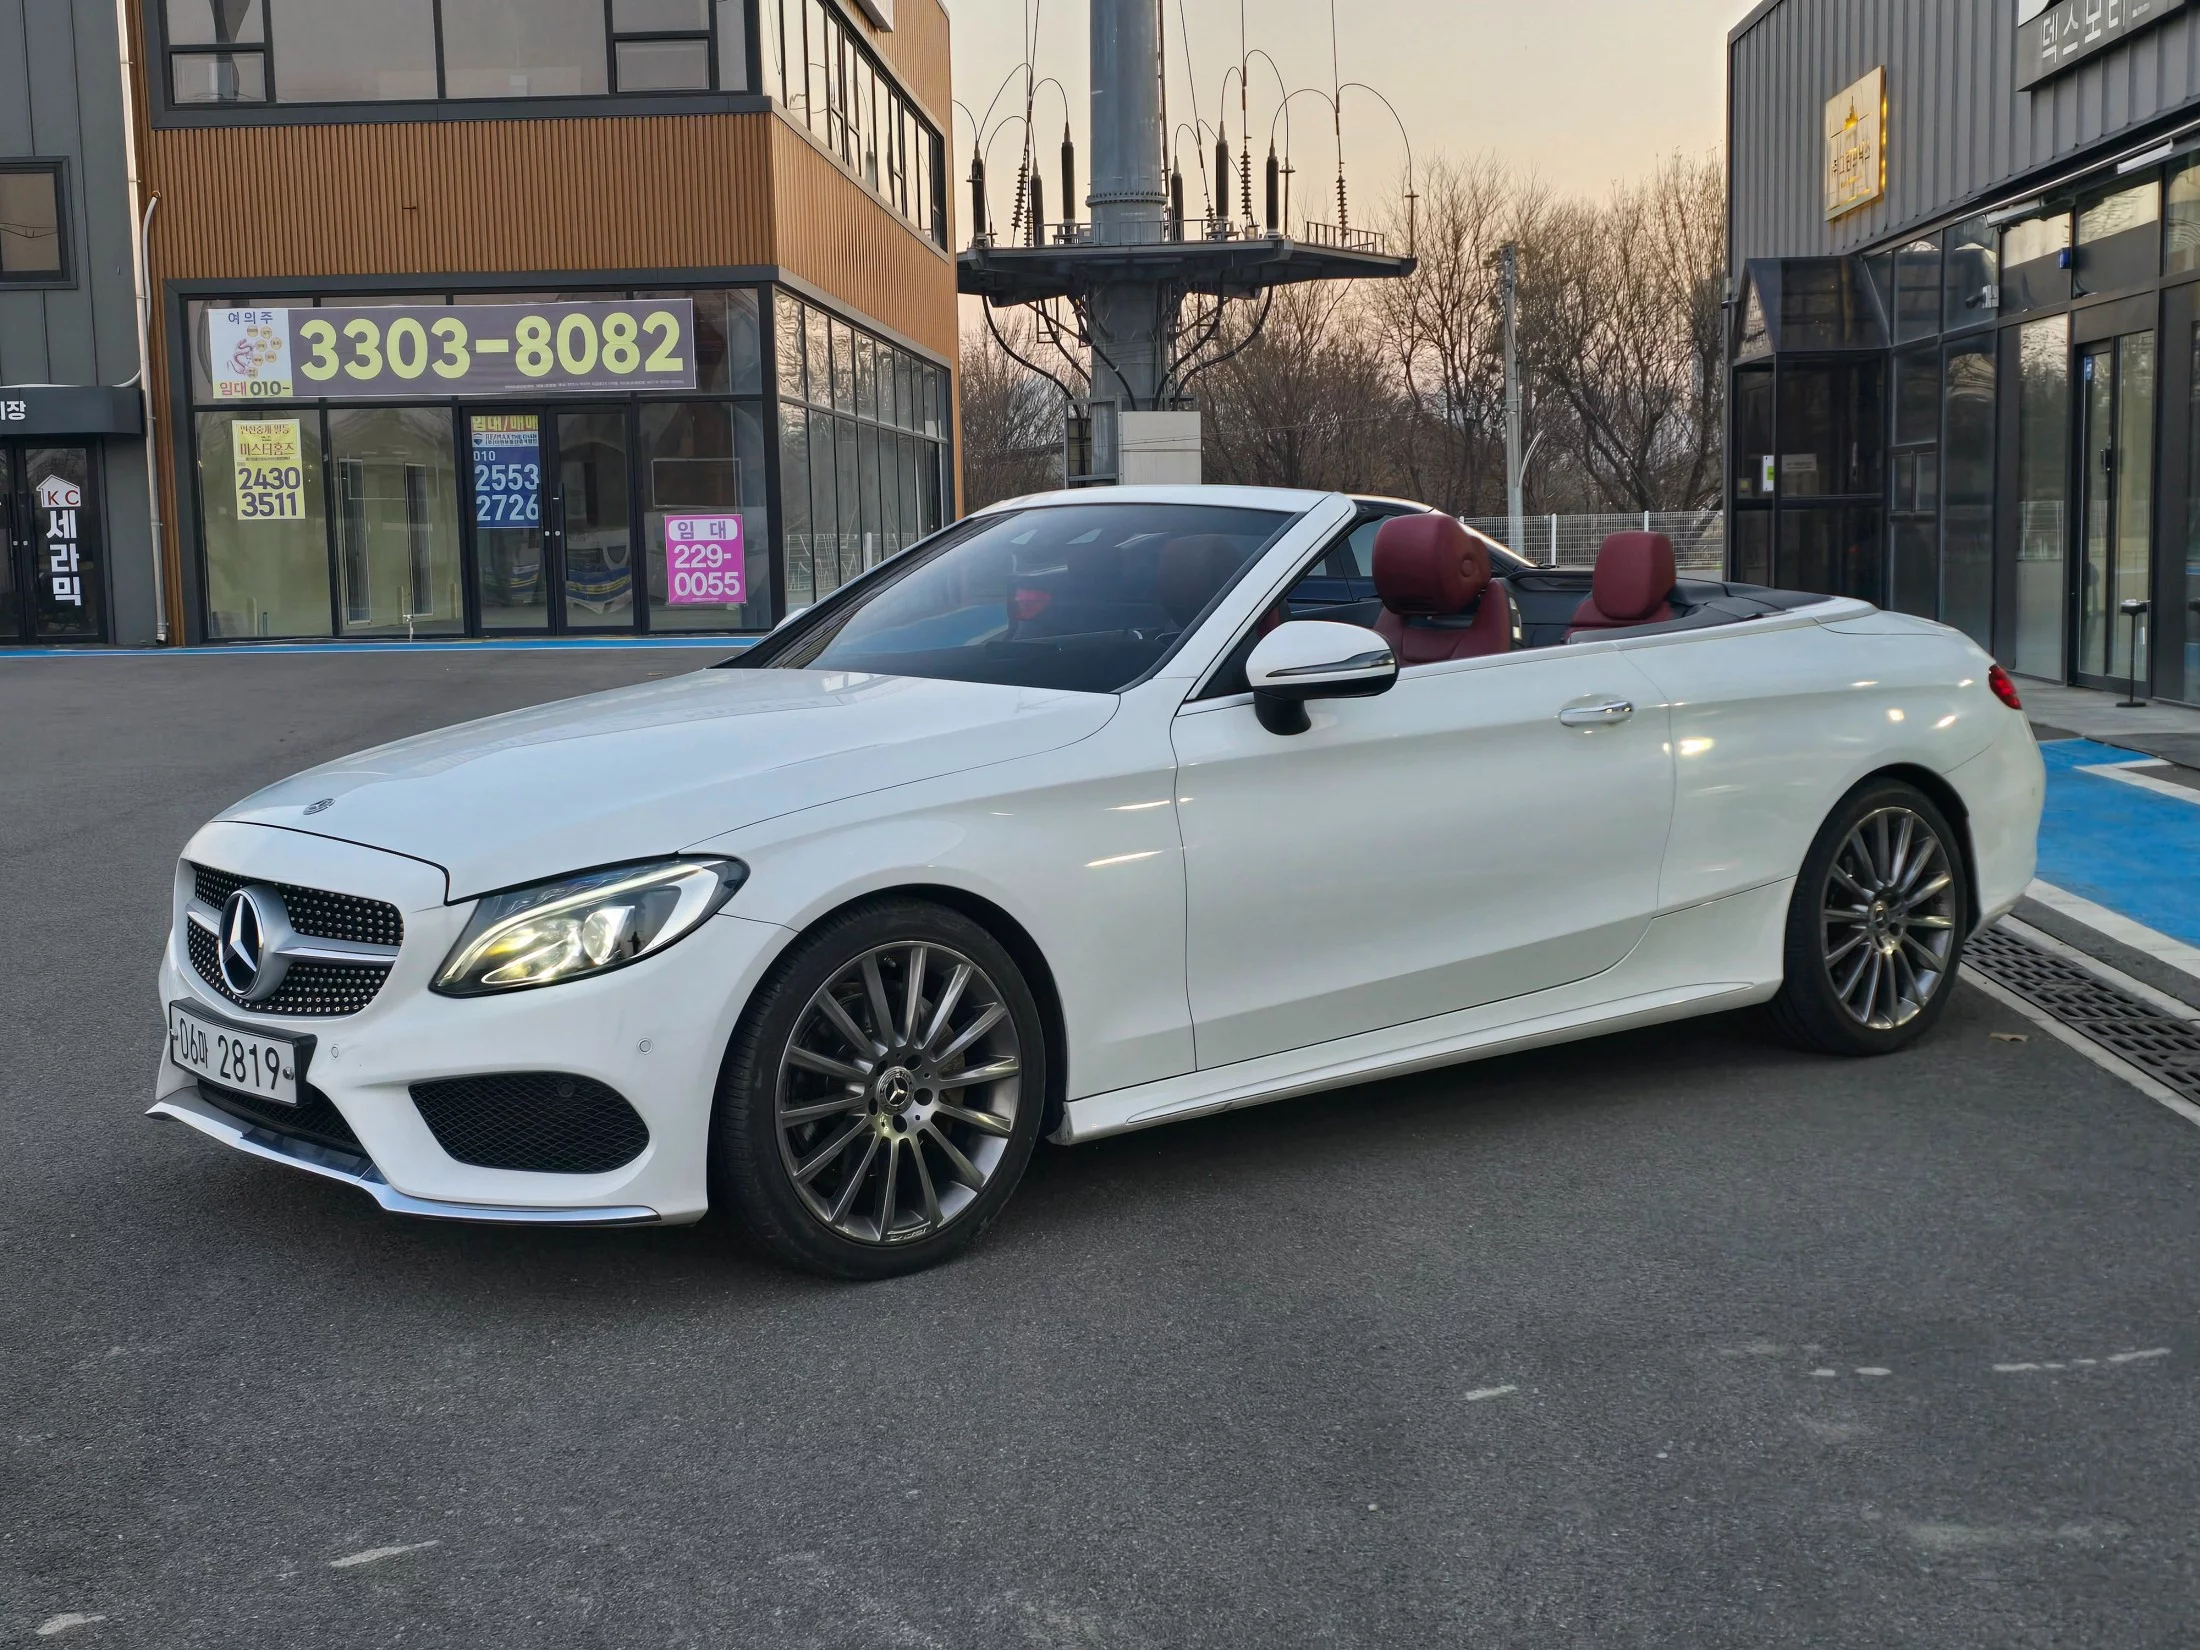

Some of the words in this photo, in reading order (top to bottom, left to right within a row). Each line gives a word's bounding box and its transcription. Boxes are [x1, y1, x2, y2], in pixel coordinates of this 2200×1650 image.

[299, 310, 684, 381] 3303-8082
[220, 381, 247, 396] 임대
[240, 442, 295, 456] 미스터홈즈
[473, 450, 496, 462] 010
[238, 466, 301, 490] 2430
[474, 463, 539, 491] 2553
[241, 492, 297, 517] 3511
[475, 493, 539, 522] 2726
[46, 509, 82, 606] 세라믹
[673, 543, 732, 569] 229-
[674, 571, 741, 596] 0055
[217, 1034, 280, 1090] 2819
